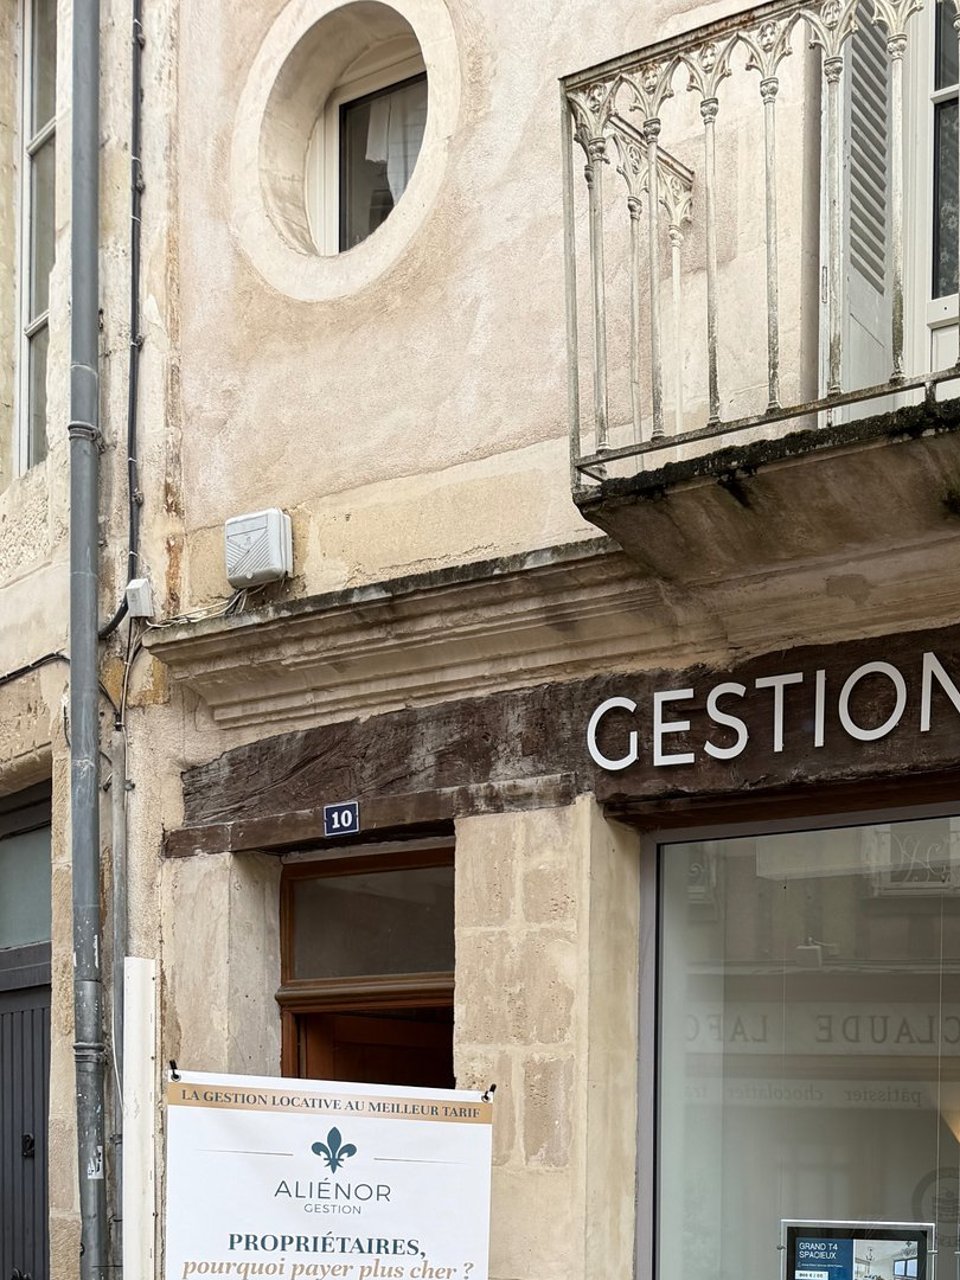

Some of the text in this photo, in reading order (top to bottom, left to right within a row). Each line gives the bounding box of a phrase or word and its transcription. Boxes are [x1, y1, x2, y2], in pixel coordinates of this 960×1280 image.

[331, 810, 353, 829] 10
[180, 1089, 481, 1119] LA GESTION LOCATIVE AU MEILLEUR TARIF
[274, 1177, 392, 1202] ALIÉNOR
[303, 1203, 362, 1215] GESTION
[228, 1231, 427, 1259] PROPRIÉTAIRES,
[798, 1242, 838, 1251] GRAND T4
[798, 1250, 837, 1260] SPACIEUX
[181, 1257, 286, 1280] pourquoi
[409, 1261, 457, 1280] cher
[463, 1262, 475, 1280] ?
